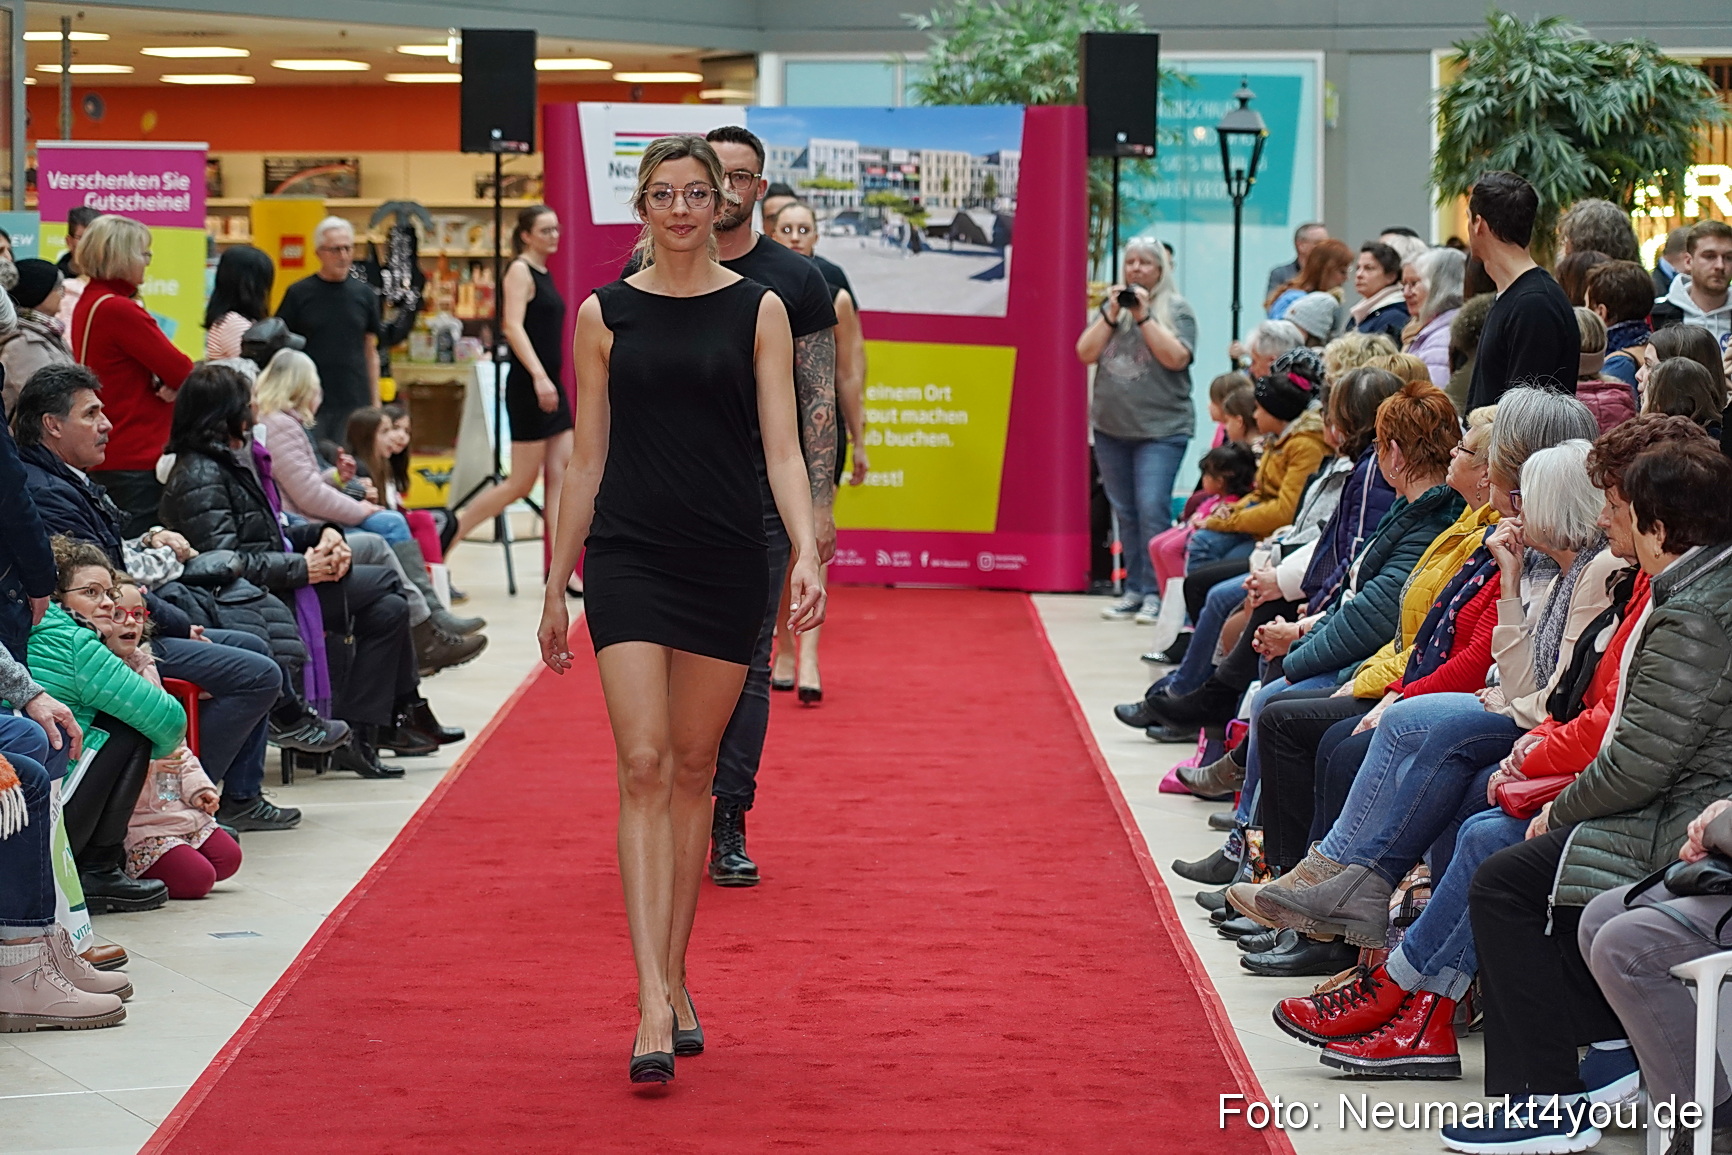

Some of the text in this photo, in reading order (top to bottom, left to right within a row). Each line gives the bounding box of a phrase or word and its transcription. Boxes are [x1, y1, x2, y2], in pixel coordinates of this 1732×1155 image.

[47, 170, 190, 191] Verschenken Sie
[84, 192, 190, 211] Gutscheine!
[10, 233, 35, 248] EW
[865, 384, 952, 402] einem Ort
[863, 407, 968, 425] out machen
[884, 429, 954, 447] buchen.
